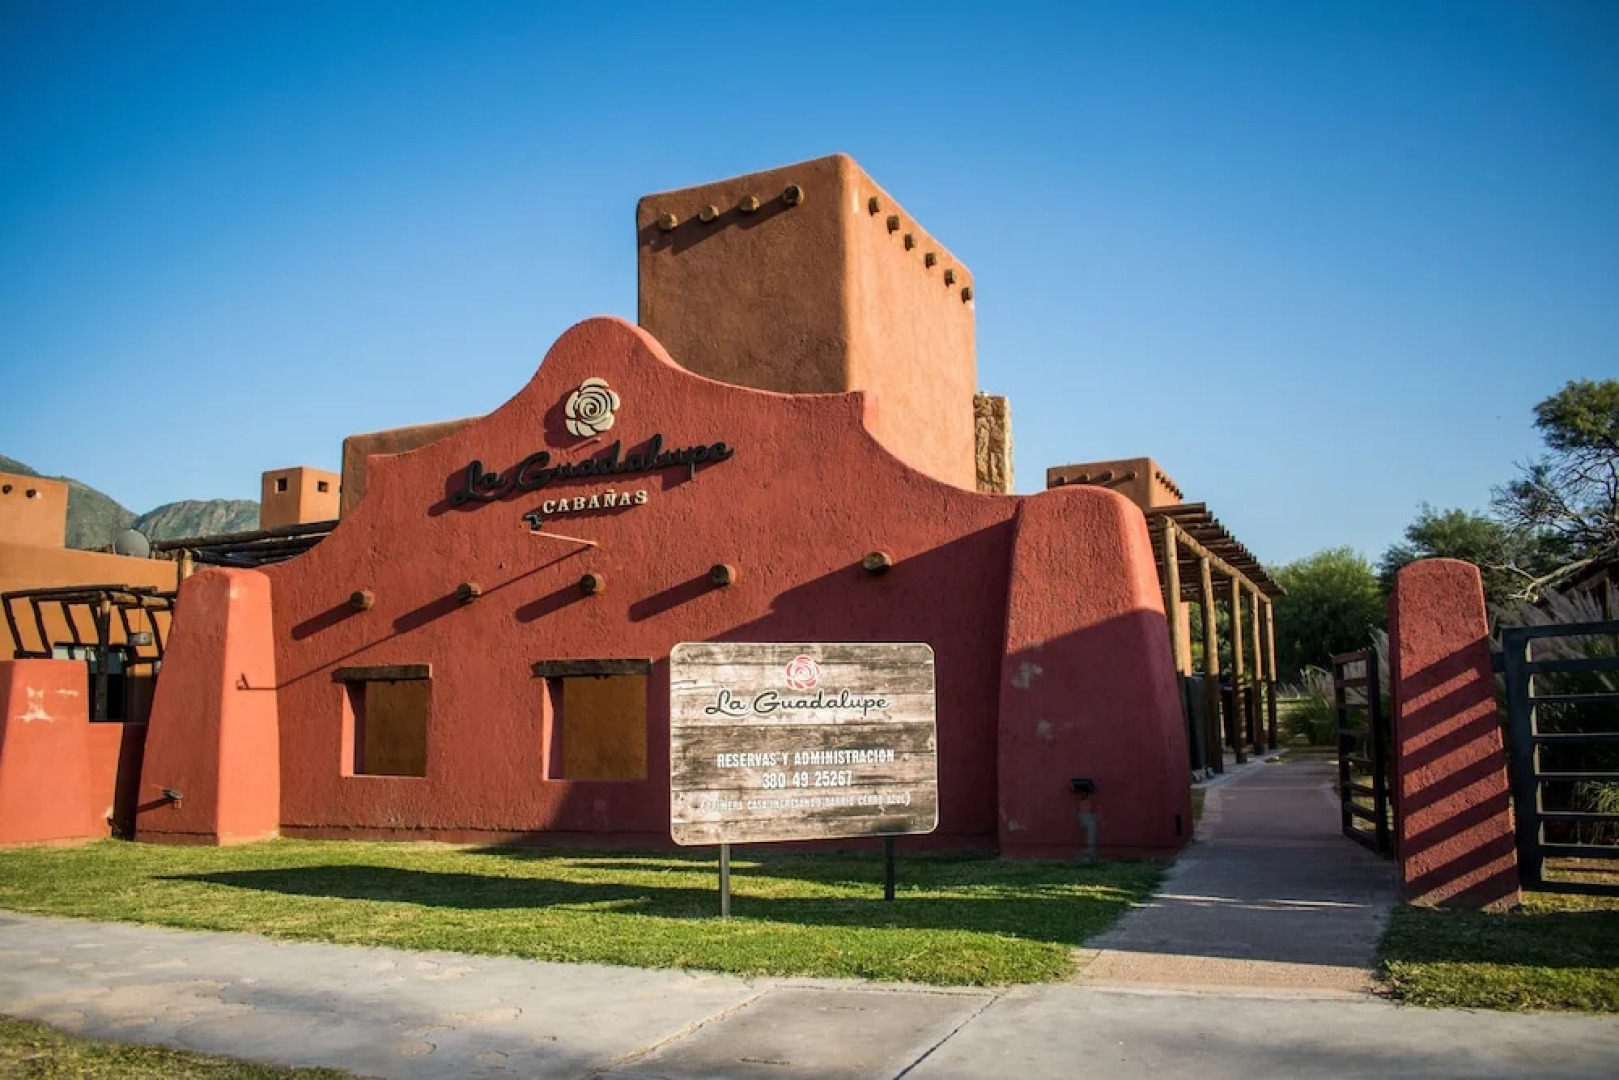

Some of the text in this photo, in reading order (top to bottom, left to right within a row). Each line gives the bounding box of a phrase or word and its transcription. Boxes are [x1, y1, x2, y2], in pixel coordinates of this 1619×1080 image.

[453, 433, 734, 505] La Guadalupe
[543, 489, 648, 514] CABAÑAS
[705, 689, 889, 716] La Guadalupe
[716, 752, 777, 768] RESERVAS
[782, 751, 789, 766] Y
[762, 770, 853, 789] 380 49 25267
